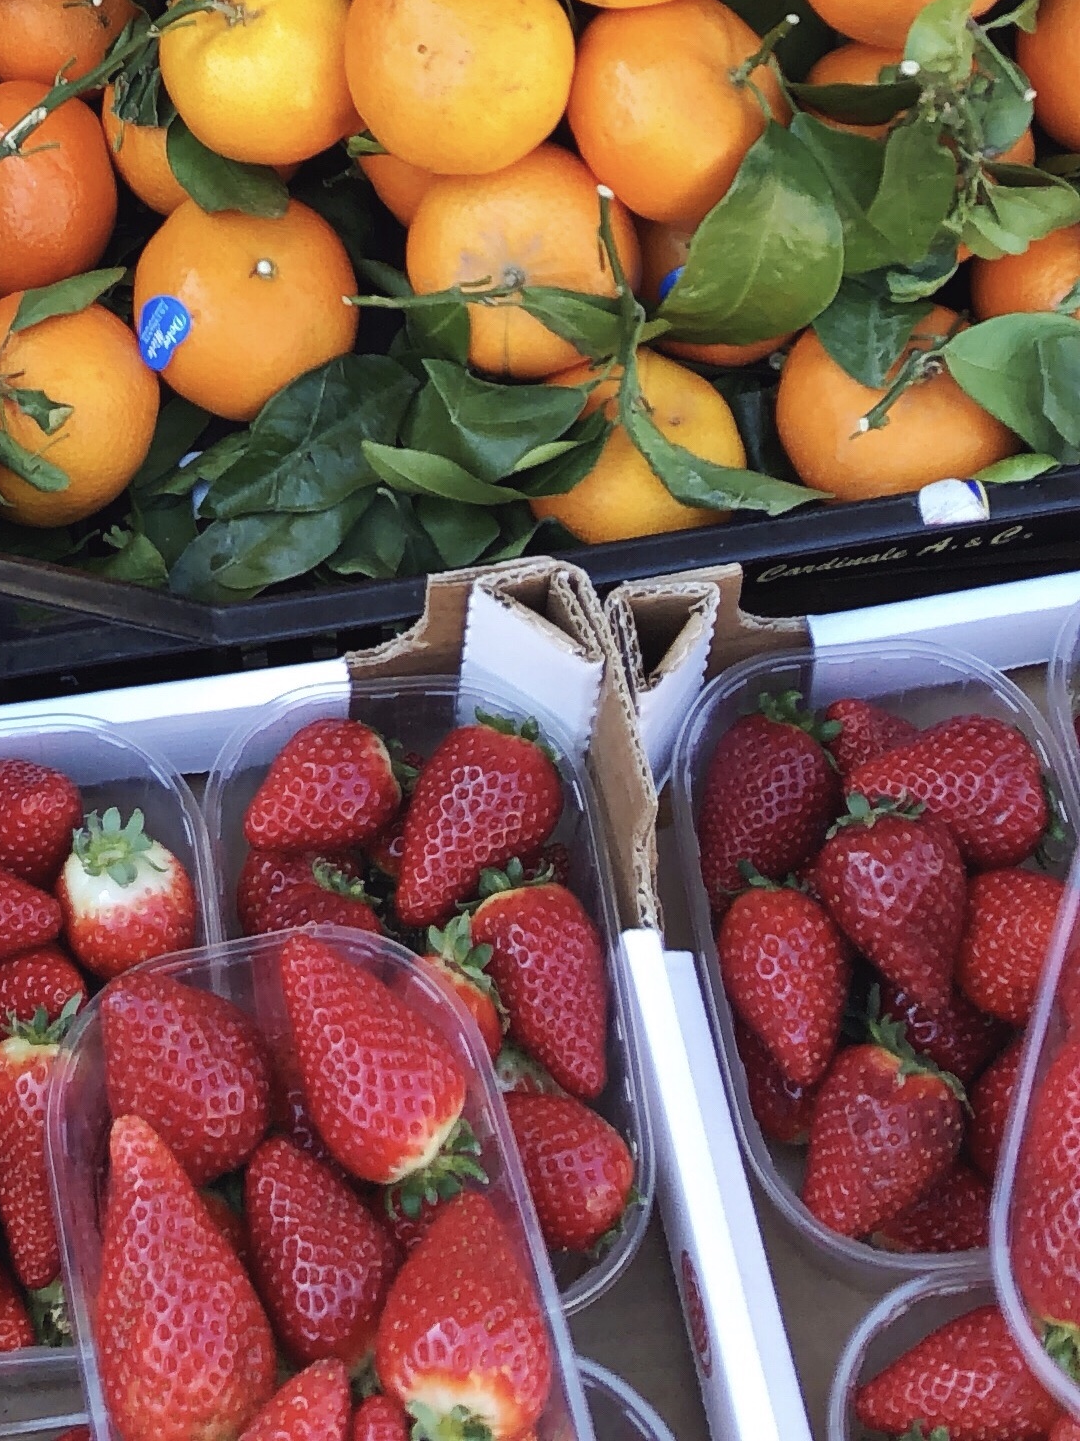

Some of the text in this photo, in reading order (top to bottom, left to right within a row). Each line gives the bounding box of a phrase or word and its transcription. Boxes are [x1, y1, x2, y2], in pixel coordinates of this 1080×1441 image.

[756, 525, 1035, 584] Cardinale A. & C.
